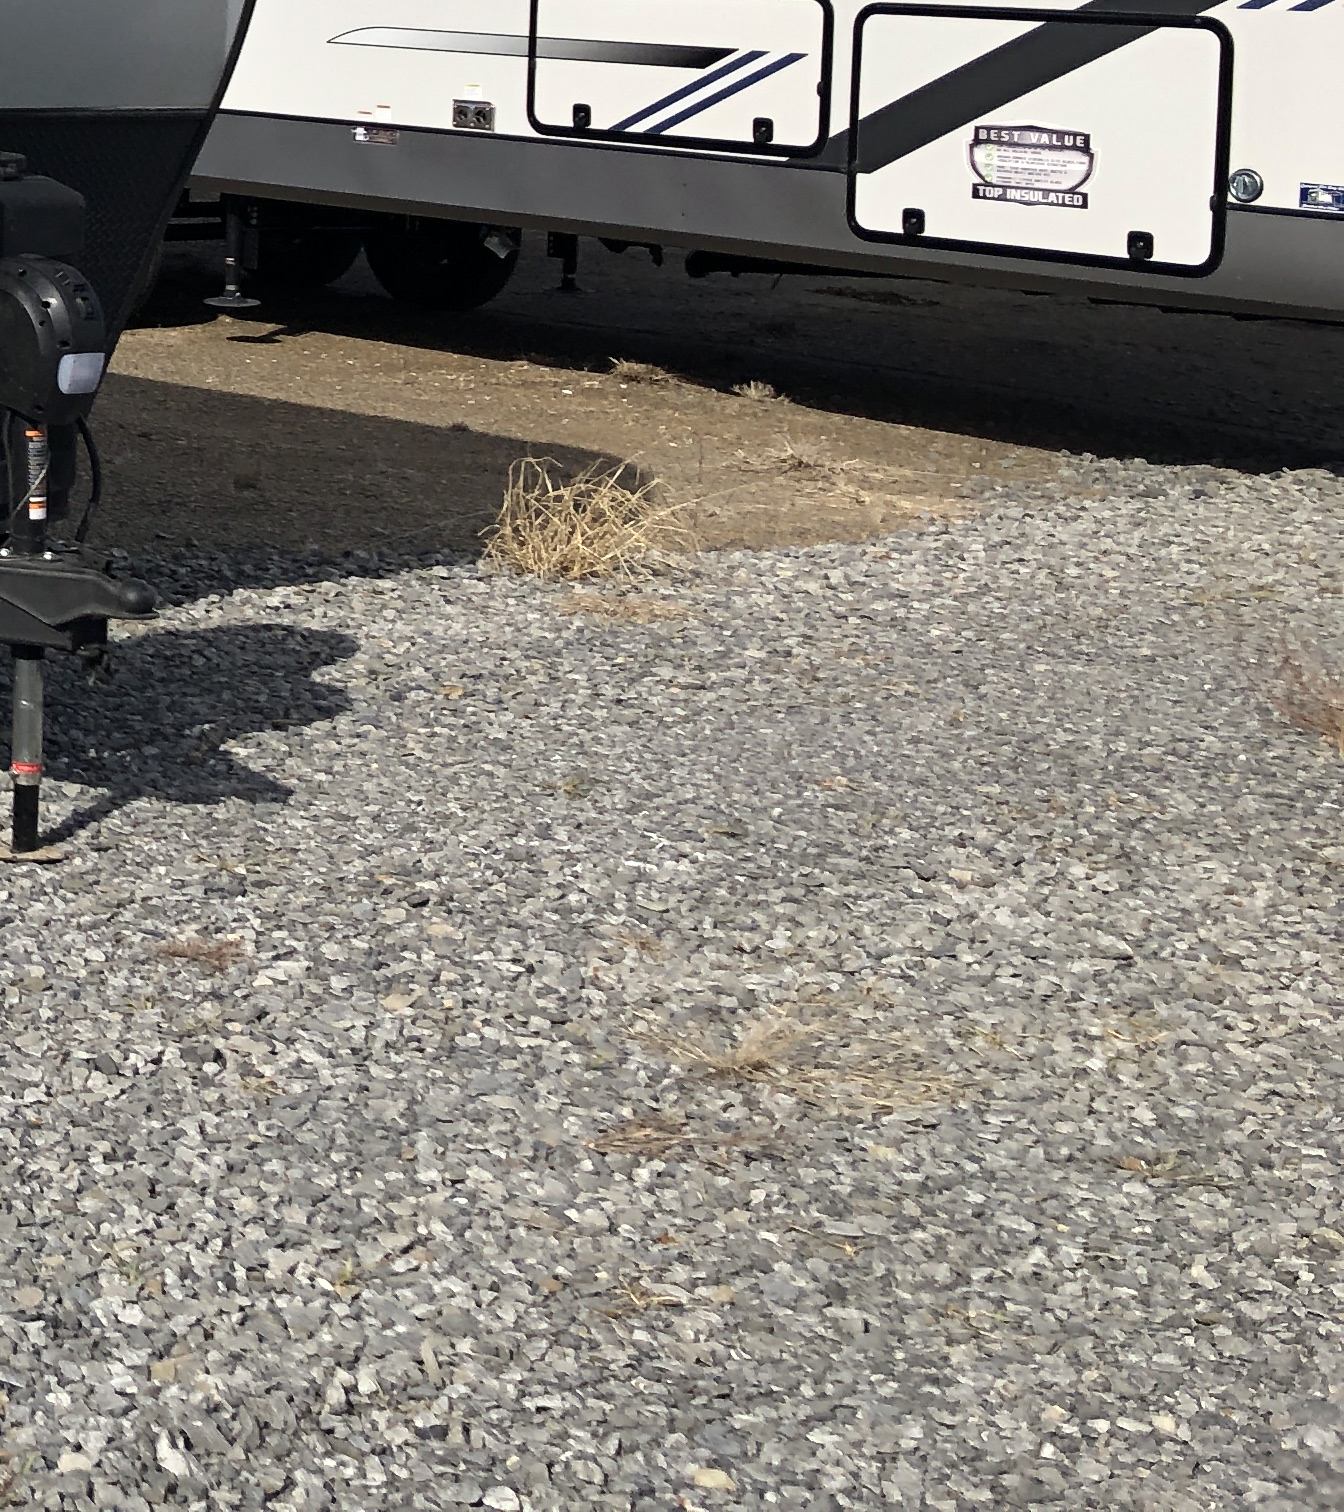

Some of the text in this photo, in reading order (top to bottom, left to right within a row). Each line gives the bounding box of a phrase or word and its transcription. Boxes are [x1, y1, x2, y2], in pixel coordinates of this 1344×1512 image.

[978, 128, 1085, 148] BEST VALUE
[976, 185, 1083, 206] TOP INSULATED
